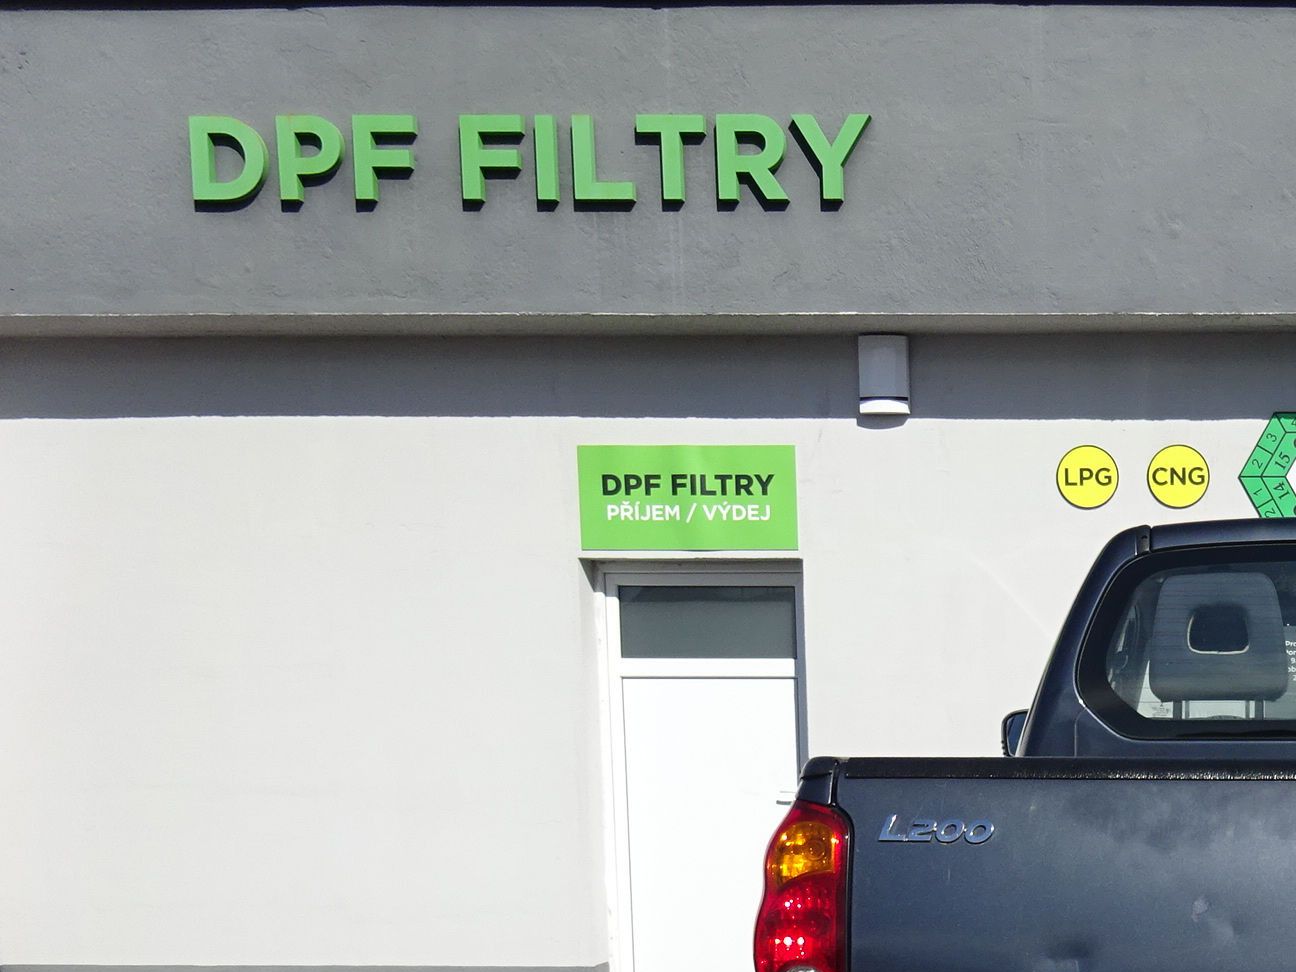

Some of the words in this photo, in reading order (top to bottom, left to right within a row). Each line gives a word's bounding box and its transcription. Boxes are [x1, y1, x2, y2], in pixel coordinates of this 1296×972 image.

[188, 114, 416, 206] DPF
[457, 113, 872, 206] FILTRY
[1265, 432, 1278, 442] 3
[1251, 458, 1264, 469] 2
[1274, 451, 1291, 470] 15
[601, 473, 661, 496] DPF
[671, 473, 775, 496] FILTRY
[1064, 467, 1113, 486] LPG
[1152, 467, 1206, 486] CNG
[1272, 482, 1290, 500] 14
[606, 501, 680, 521] PŘÍJEM
[685, 503, 697, 523] /
[703, 501, 771, 521] VÝDEJ
[878, 814, 995, 844] L200
